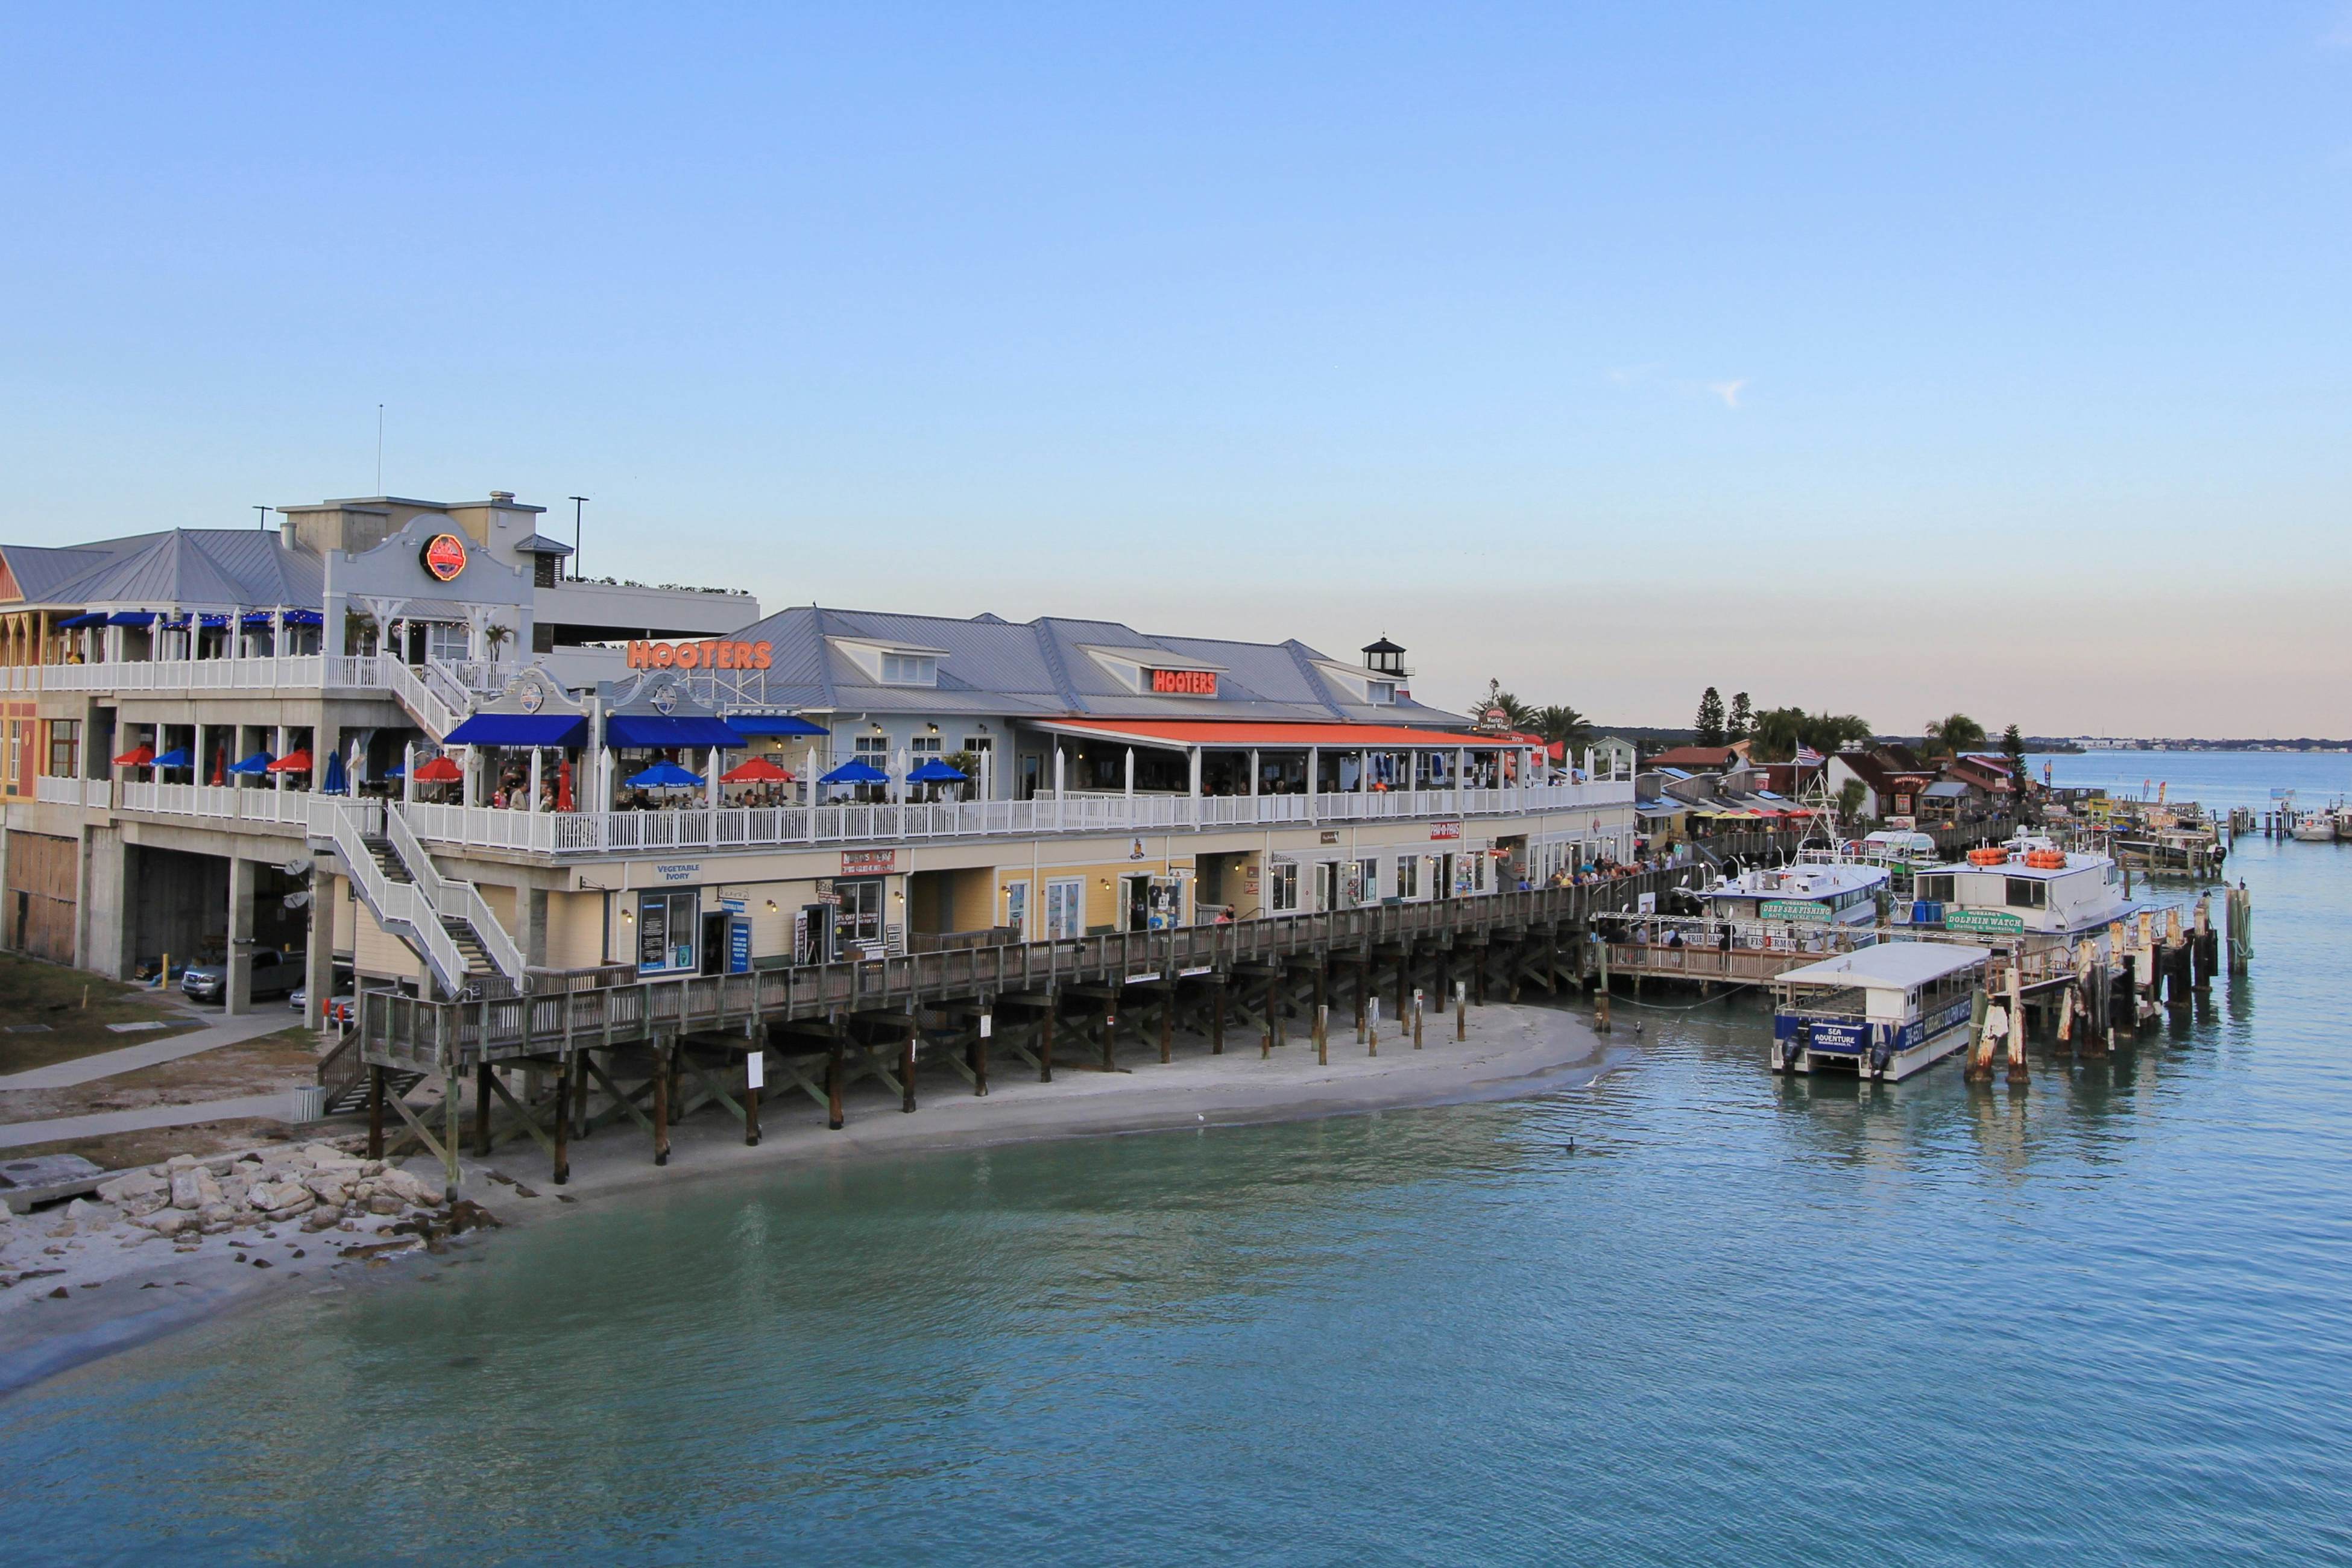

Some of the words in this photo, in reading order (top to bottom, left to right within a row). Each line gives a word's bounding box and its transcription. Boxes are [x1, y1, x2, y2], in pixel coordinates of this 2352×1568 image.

[627, 640, 772, 669] HOOTERS
[1153, 670, 1216, 694] HOOTERS
[1949, 916, 1988, 925] DOLPHIN
[1990, 918, 2022, 927] WATCH
[1688, 934, 1723, 943] FRIEDLY
[1751, 937, 1797, 949] FISERMAN
[1815, 1034, 1855, 1044] ADVENTURE
